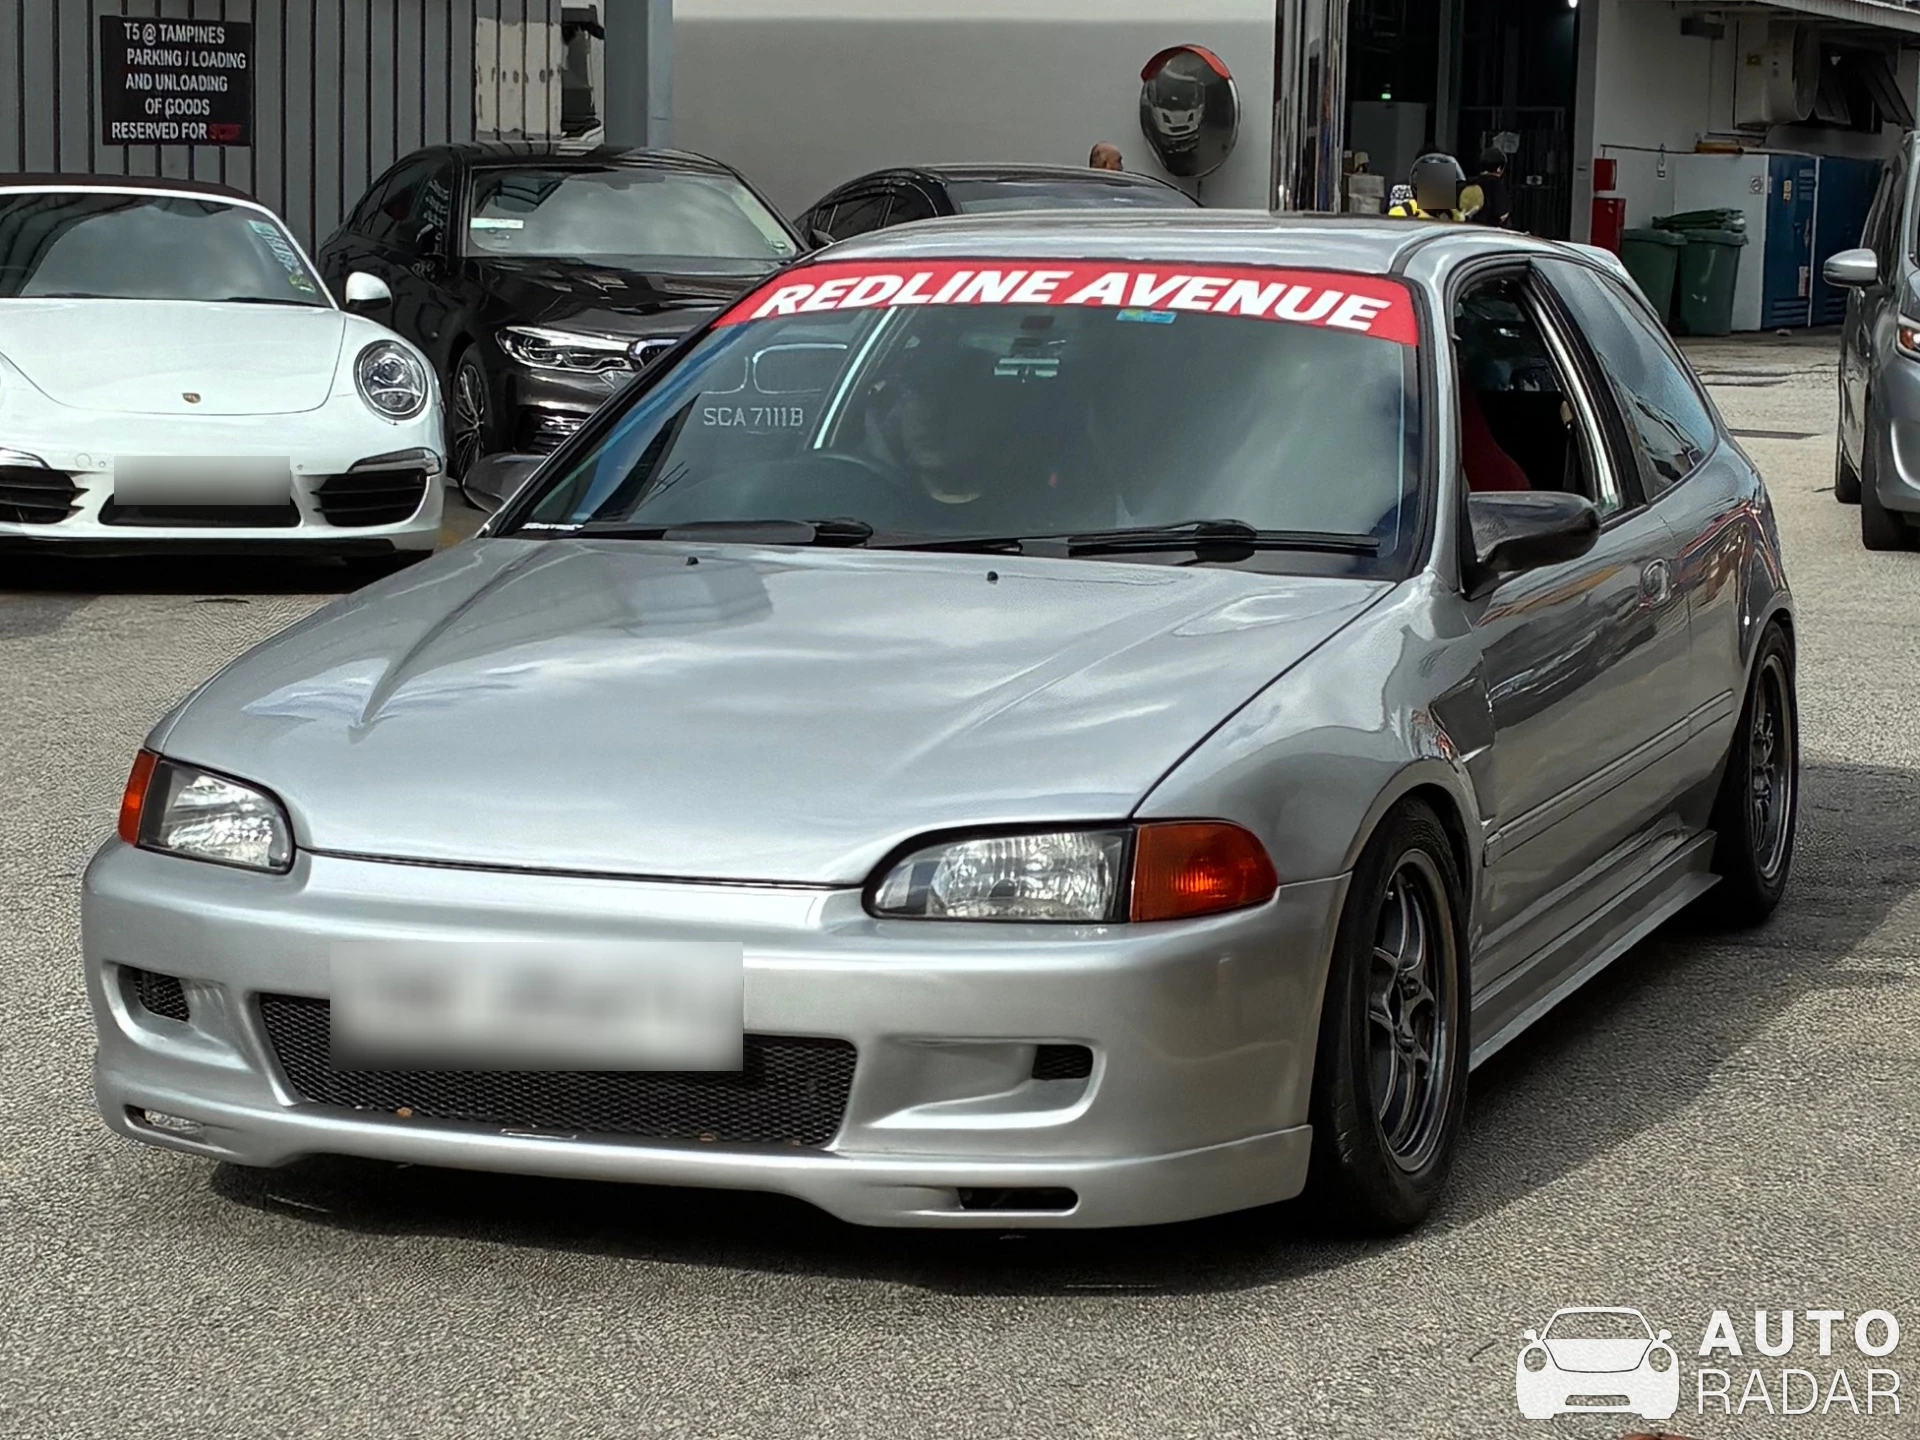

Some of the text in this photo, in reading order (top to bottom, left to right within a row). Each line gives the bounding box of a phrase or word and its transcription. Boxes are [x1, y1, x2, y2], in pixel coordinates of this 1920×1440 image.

[124, 23, 225, 46] T5 @ TAMPINES
[127, 48, 182, 66] PARKING
[192, 51, 246, 69] LOADING
[126, 73, 228, 92] AND UNLOADING
[145, 98, 210, 118] OF GOODS
[112, 122, 179, 139] RESERVED
[182, 122, 207, 139] FOR
[751, 271, 1390, 331] REDLINE AVENUE
[703, 407, 804, 427] SCA 7111B
